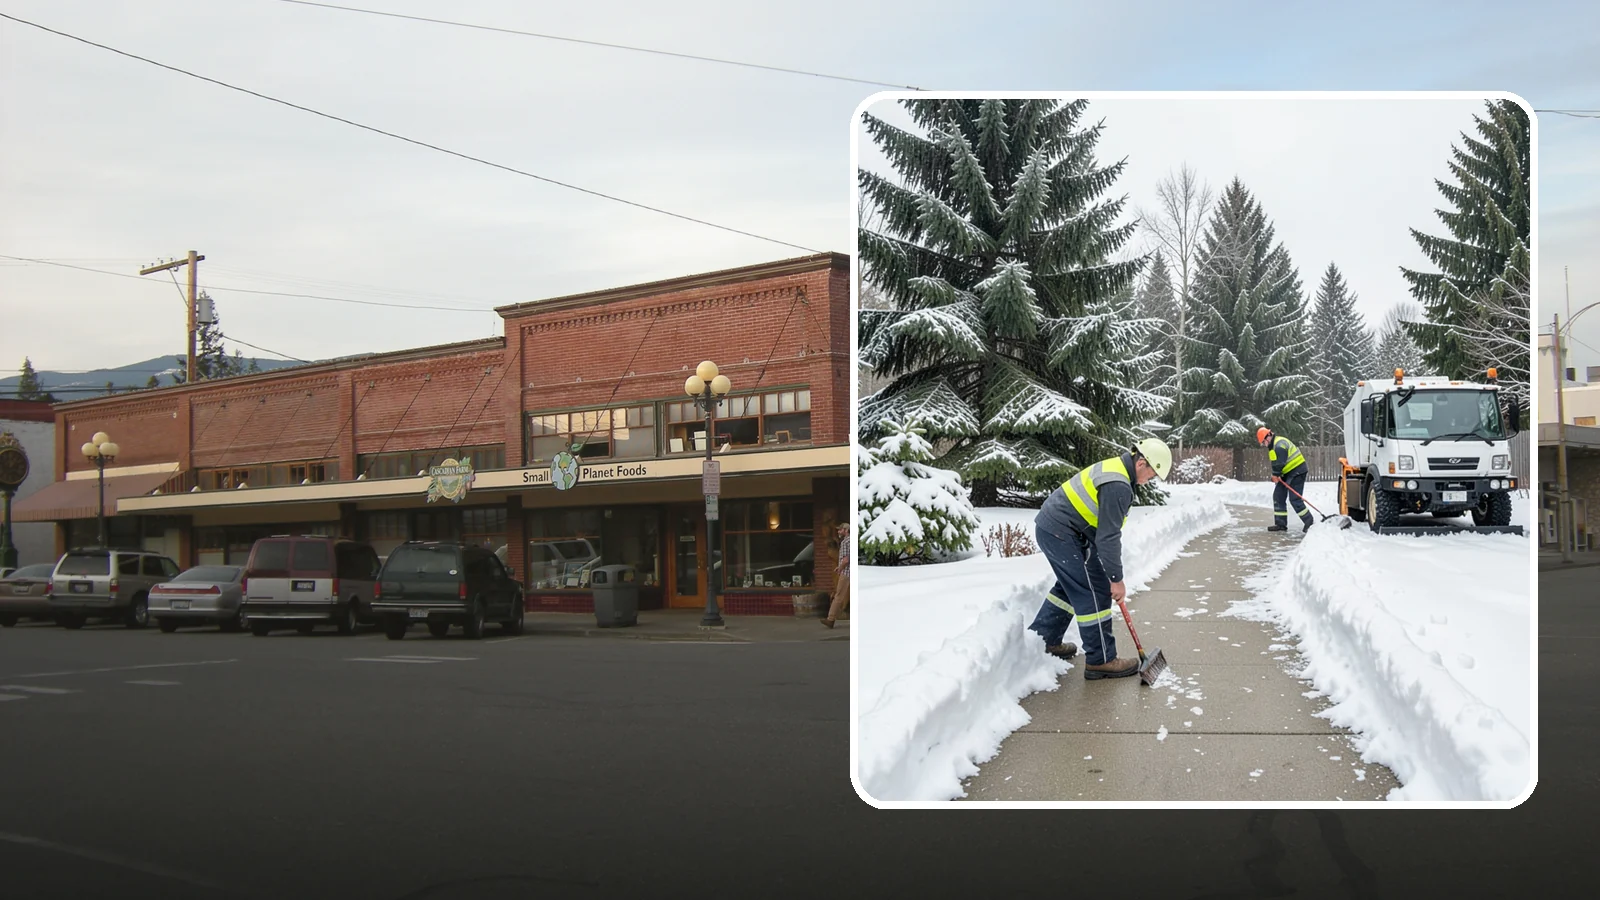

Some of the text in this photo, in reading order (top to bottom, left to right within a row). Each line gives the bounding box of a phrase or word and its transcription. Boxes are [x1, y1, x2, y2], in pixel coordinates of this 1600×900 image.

[523, 464, 647, 483] Small Planet Foods
